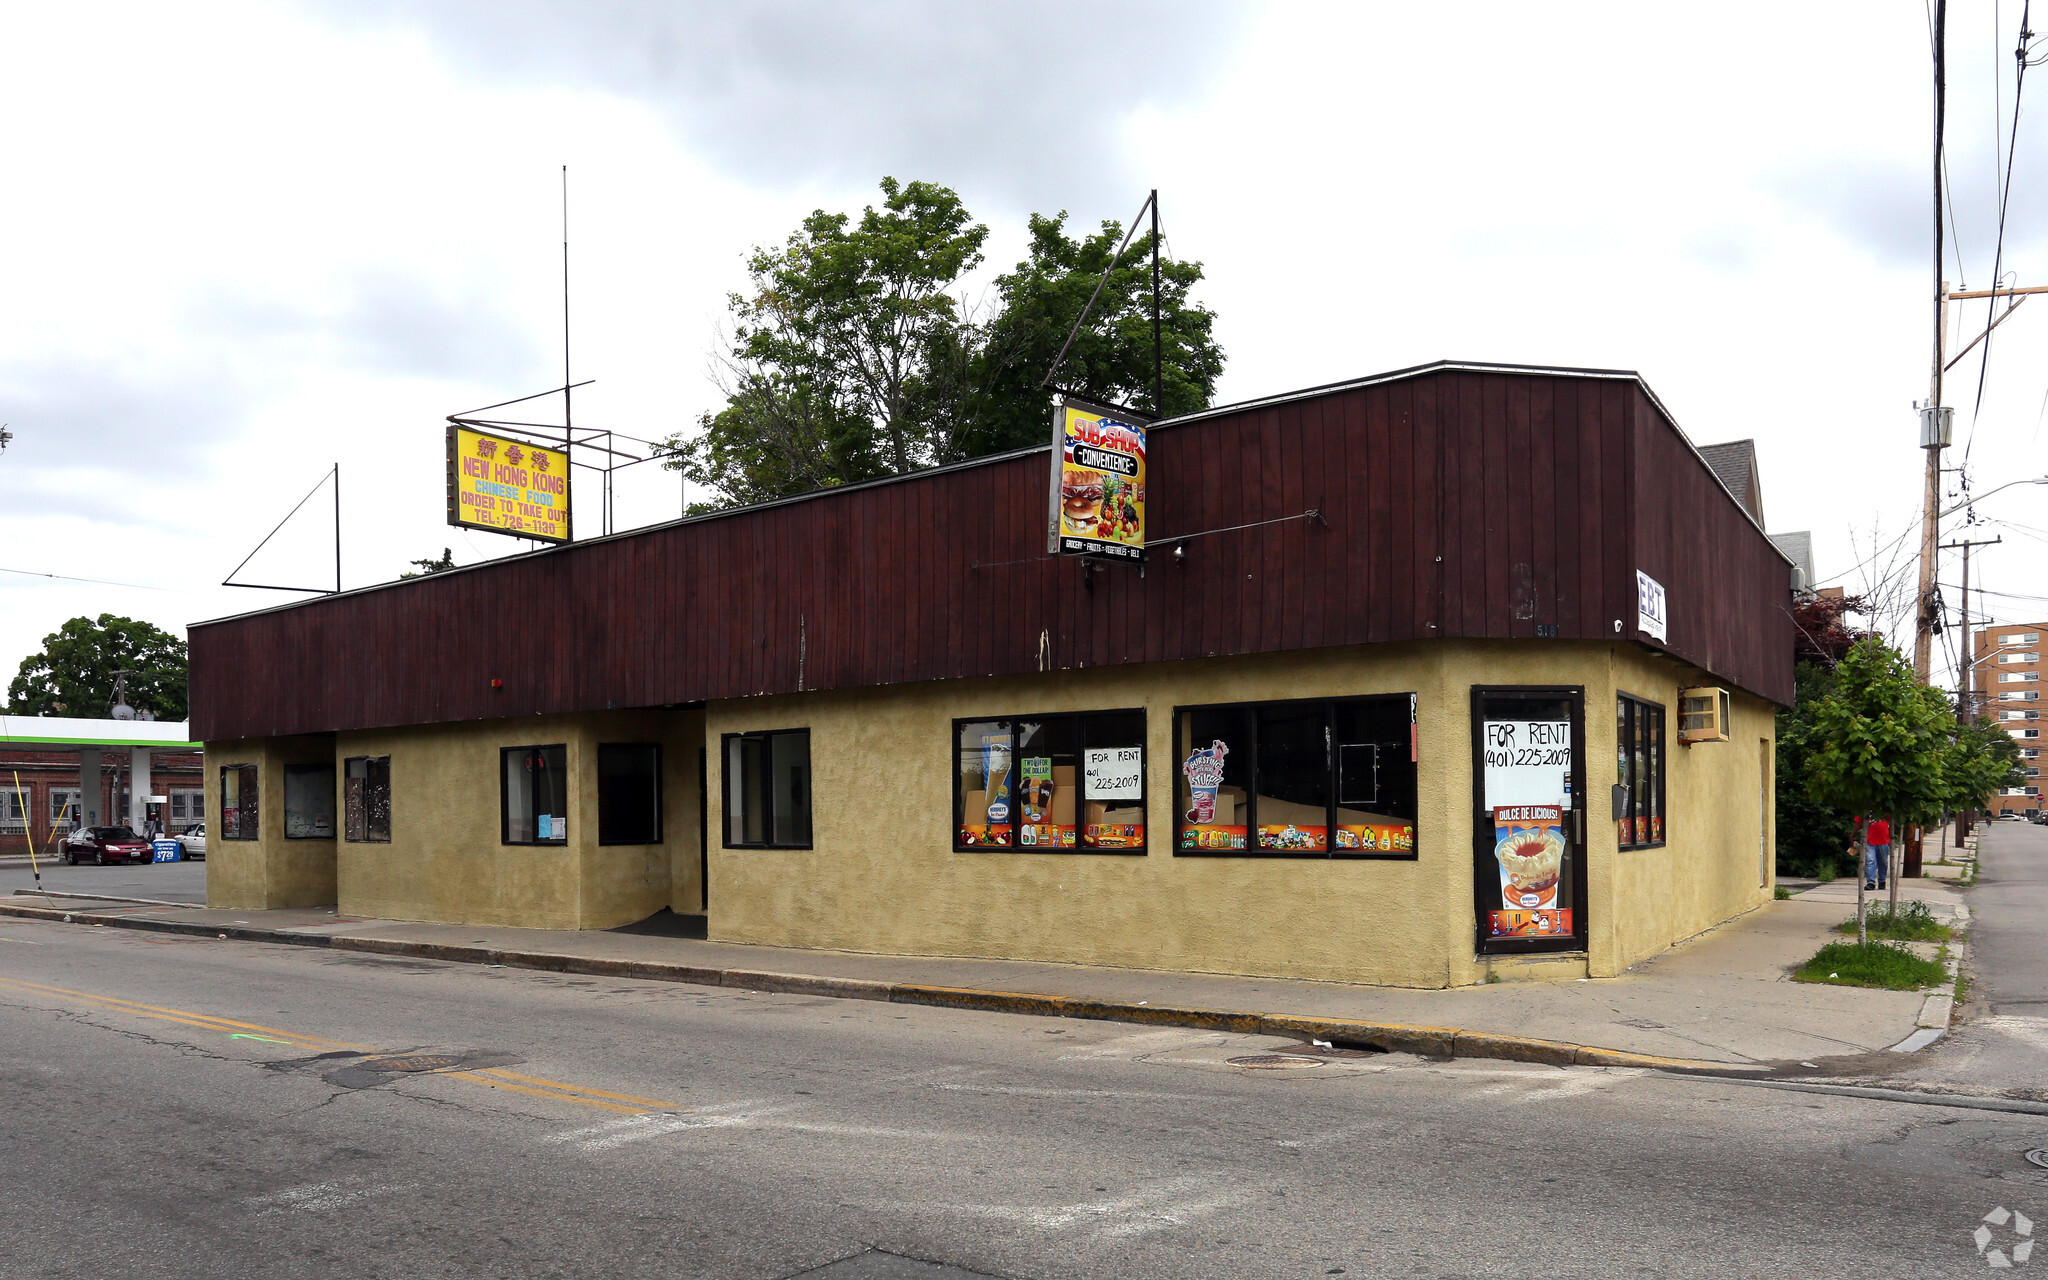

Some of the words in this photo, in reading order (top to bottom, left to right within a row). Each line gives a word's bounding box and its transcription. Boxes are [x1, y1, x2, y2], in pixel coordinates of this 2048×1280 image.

[1073, 418, 1100, 446] SUB
[1105, 426, 1139, 455] SHOP
[477, 438, 550, 471] 新香港
[463, 456, 490, 480] NEW
[495, 463, 528, 488] HONG
[532, 471, 564, 495] KONG
[475, 479, 519, 500] CHINESE
[527, 490, 554, 506] FOOD
[461, 491, 495, 509] ORDER
[500, 498, 513, 513] TO
[518, 502, 542, 518] TAKE
[548, 508, 567, 523] OUT
[1066, 539, 1083, 550] GROCERY
[1086, 542, 1102, 553] FRUITS
[1106, 545, 1127, 556] VEGETABLES
[1130, 549, 1140, 558] DELI
[1639, 576, 1662, 620] EBT
[1487, 724, 1515, 748] FOR
[1528, 723, 1568, 744] RENT
[1024, 759, 1034, 767] TWO
[1040, 759, 1049, 767] FOR
[1091, 753, 1109, 763] FOR
[1117, 751, 1139, 761] RENT
[1189, 756, 1221, 770] BURSTING
[1023, 767, 1032, 775] ONE
[1086, 768, 1099, 776] 401
[1095, 775, 1139, 789] 225-2009
[1499, 807, 1520, 820] DULCE
[1521, 807, 1530, 820] DE
[1531, 807, 1558, 820] LICIOUS!
